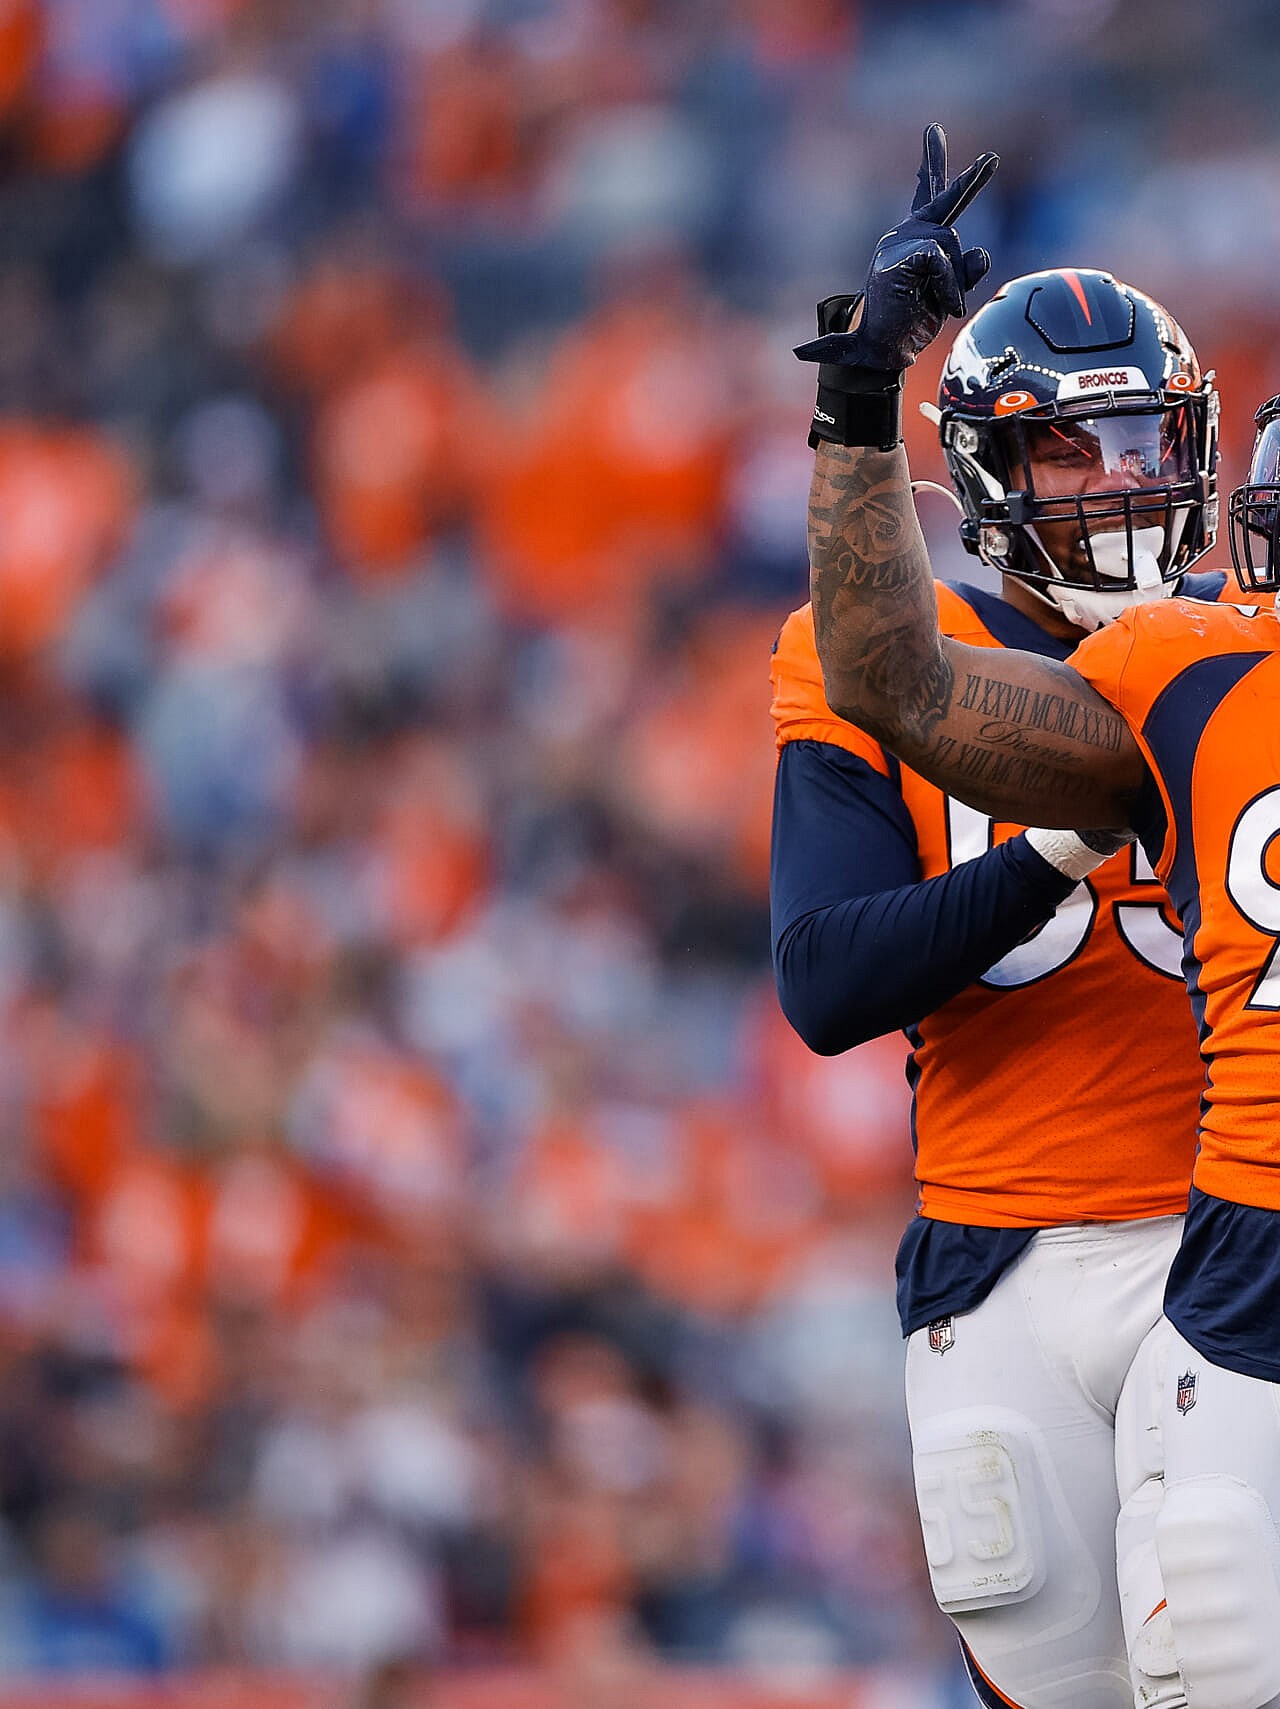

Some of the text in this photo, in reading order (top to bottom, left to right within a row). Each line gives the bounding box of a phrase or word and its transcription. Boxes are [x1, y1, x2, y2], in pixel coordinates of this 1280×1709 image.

[1078, 371, 1129, 389] BRONCOS
[930, 1328, 950, 1349] NFL
[1176, 1387, 1194, 1408] NFL
